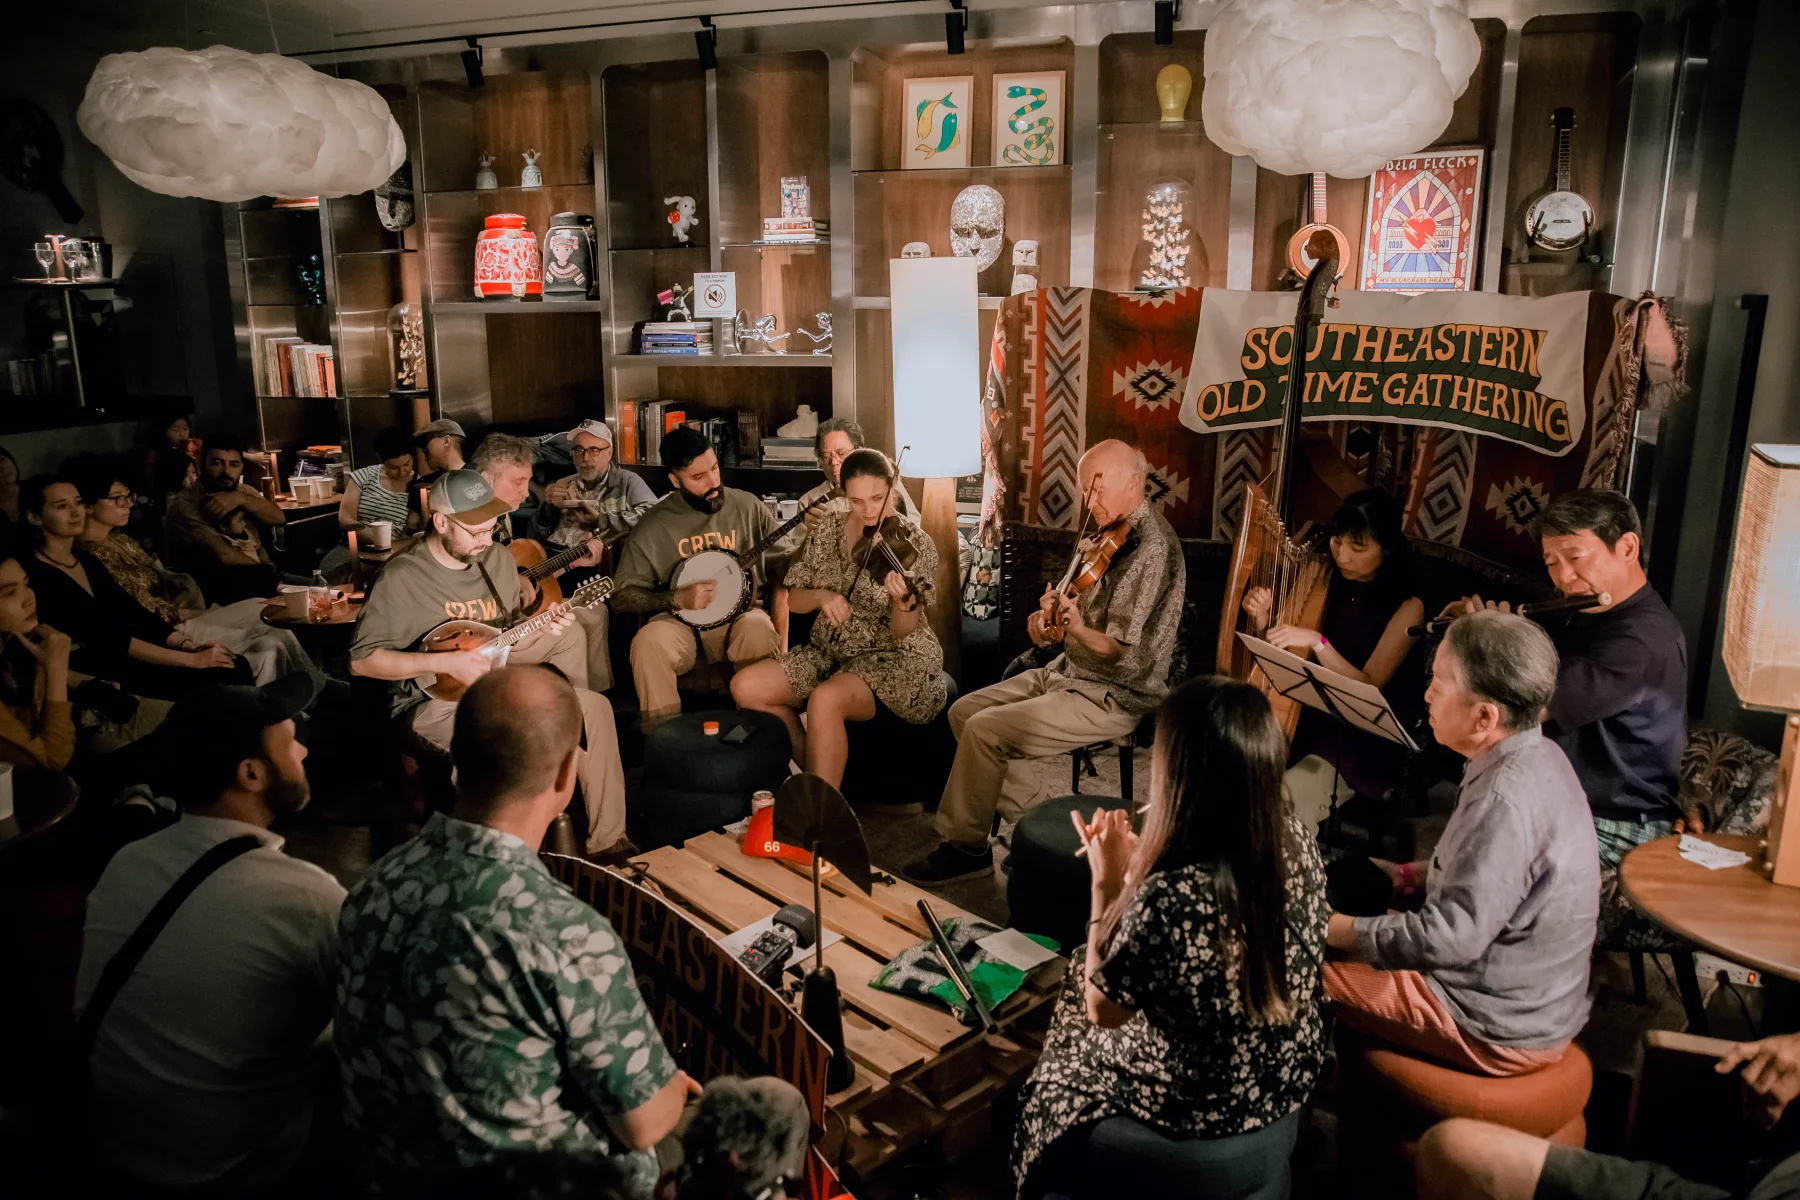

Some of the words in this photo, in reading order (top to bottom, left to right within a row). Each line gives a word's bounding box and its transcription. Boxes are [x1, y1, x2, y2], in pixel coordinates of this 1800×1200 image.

[1197, 379, 1266, 421] OLD
[1278, 371, 1379, 404] IME
[1382, 371, 1573, 443] GATHERING
[678, 529, 737, 558] CREW
[764, 841, 781, 852] 66
